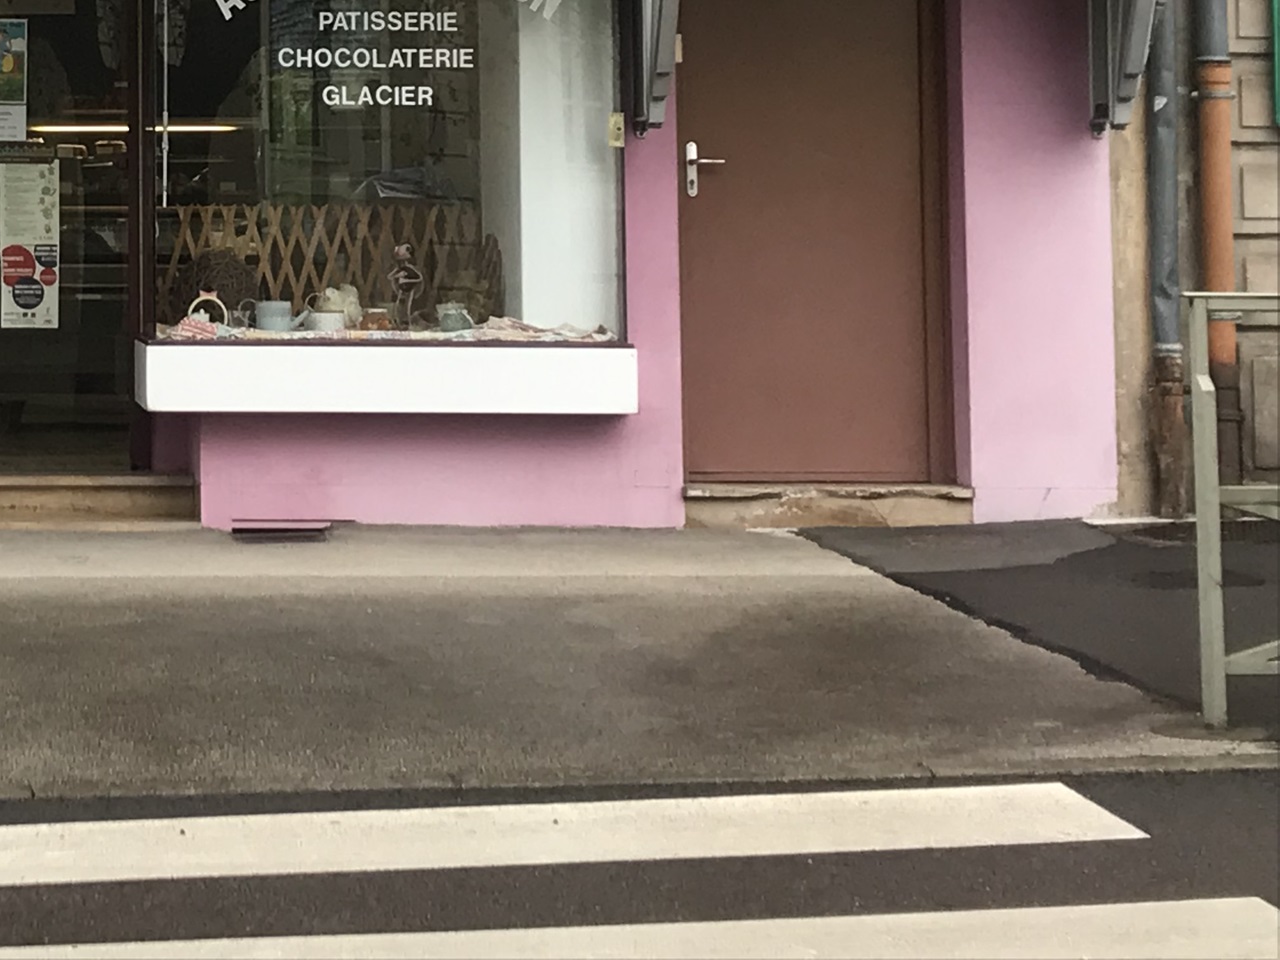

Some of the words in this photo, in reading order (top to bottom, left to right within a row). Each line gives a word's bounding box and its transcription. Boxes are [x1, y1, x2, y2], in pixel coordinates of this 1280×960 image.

[318, 11, 458, 32] PATISSERIE
[277, 48, 475, 69] CHOCOLATERIE
[322, 84, 434, 107] GLACIER
